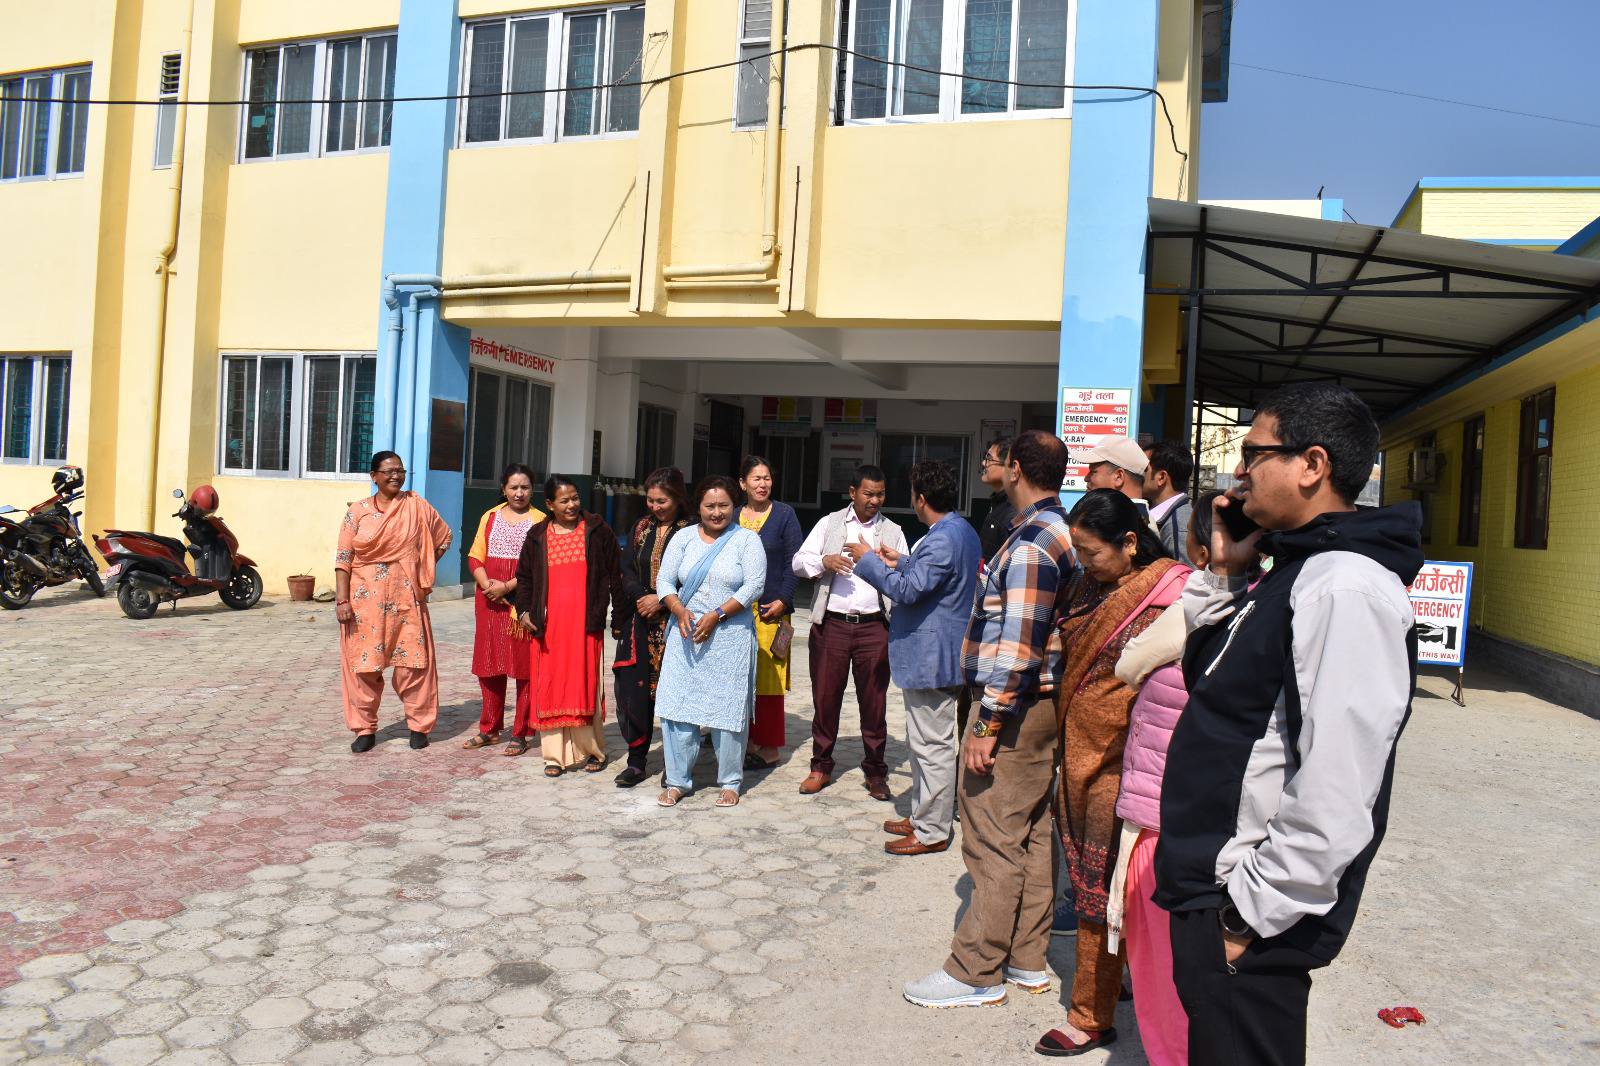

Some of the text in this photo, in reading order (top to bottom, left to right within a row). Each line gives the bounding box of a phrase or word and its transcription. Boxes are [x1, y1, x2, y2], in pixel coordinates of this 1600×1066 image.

[1095, 392, 1115, 401] तला
[1065, 415, 1127, 424] EMERGENCY -101
[1064, 435, 1085, 443] X-RAY
[1409, 600, 1463, 619] MERGENCY
[1418, 650, 1439, 659] (THIS
